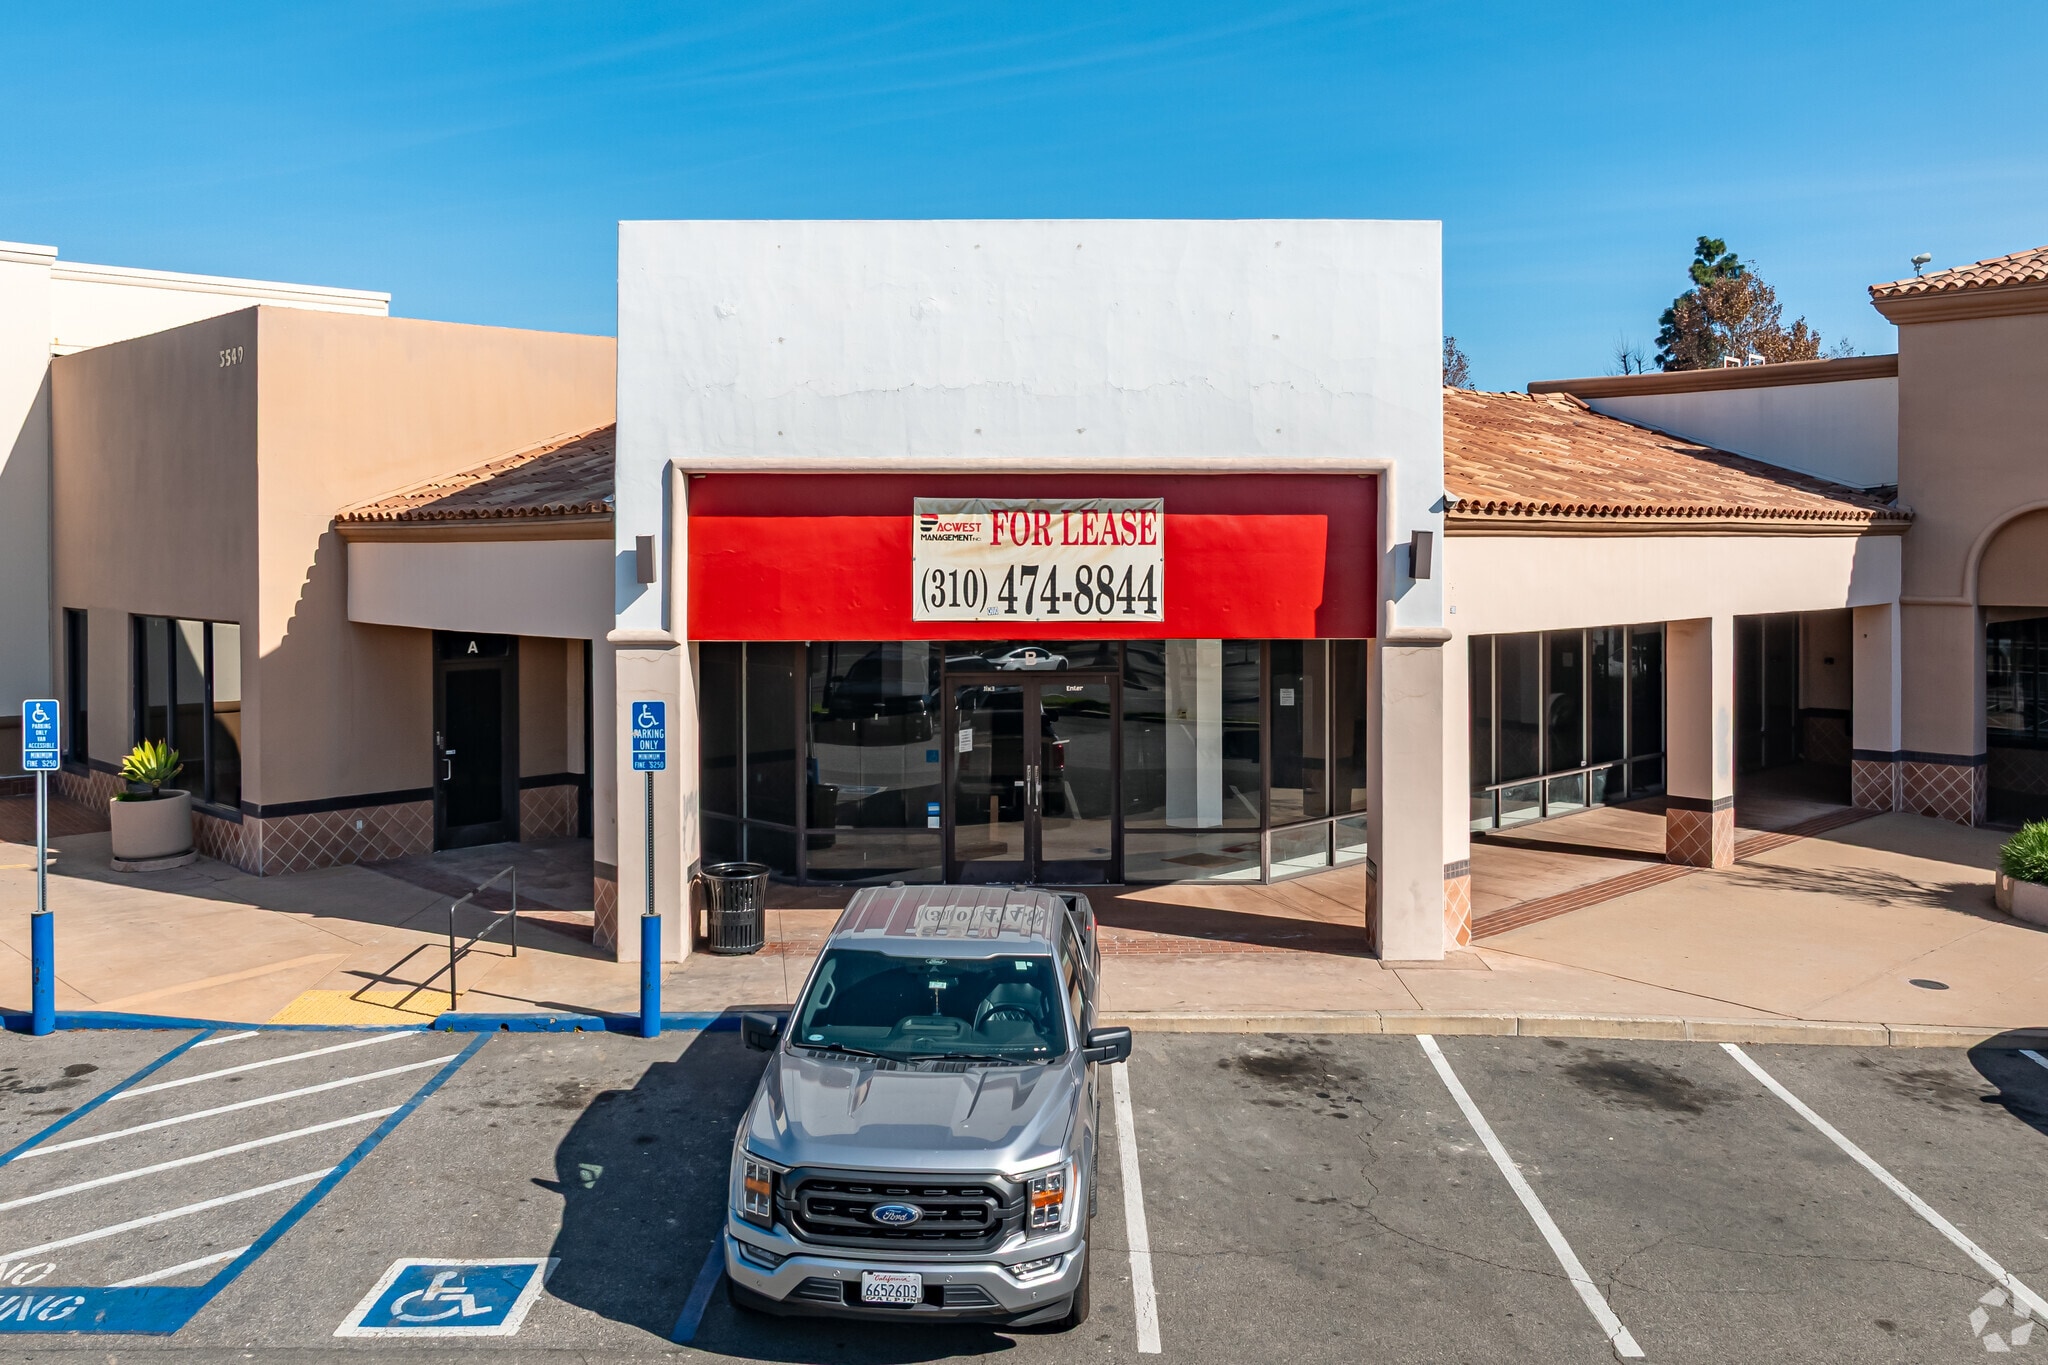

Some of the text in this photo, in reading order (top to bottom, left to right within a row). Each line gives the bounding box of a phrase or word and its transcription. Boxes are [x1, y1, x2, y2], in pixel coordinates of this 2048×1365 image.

[990, 508, 1157, 546] FOR LEASE
[921, 564, 1157, 615] (310) 474-8844
[467, 640, 479, 654] A
[1025, 651, 1037, 666] B
[640, 740, 658, 749] ONLY
[882, 1209, 908, 1221] Ford
[874, 1274, 911, 1283] California
[866, 1283, 917, 1298] 66526D3
